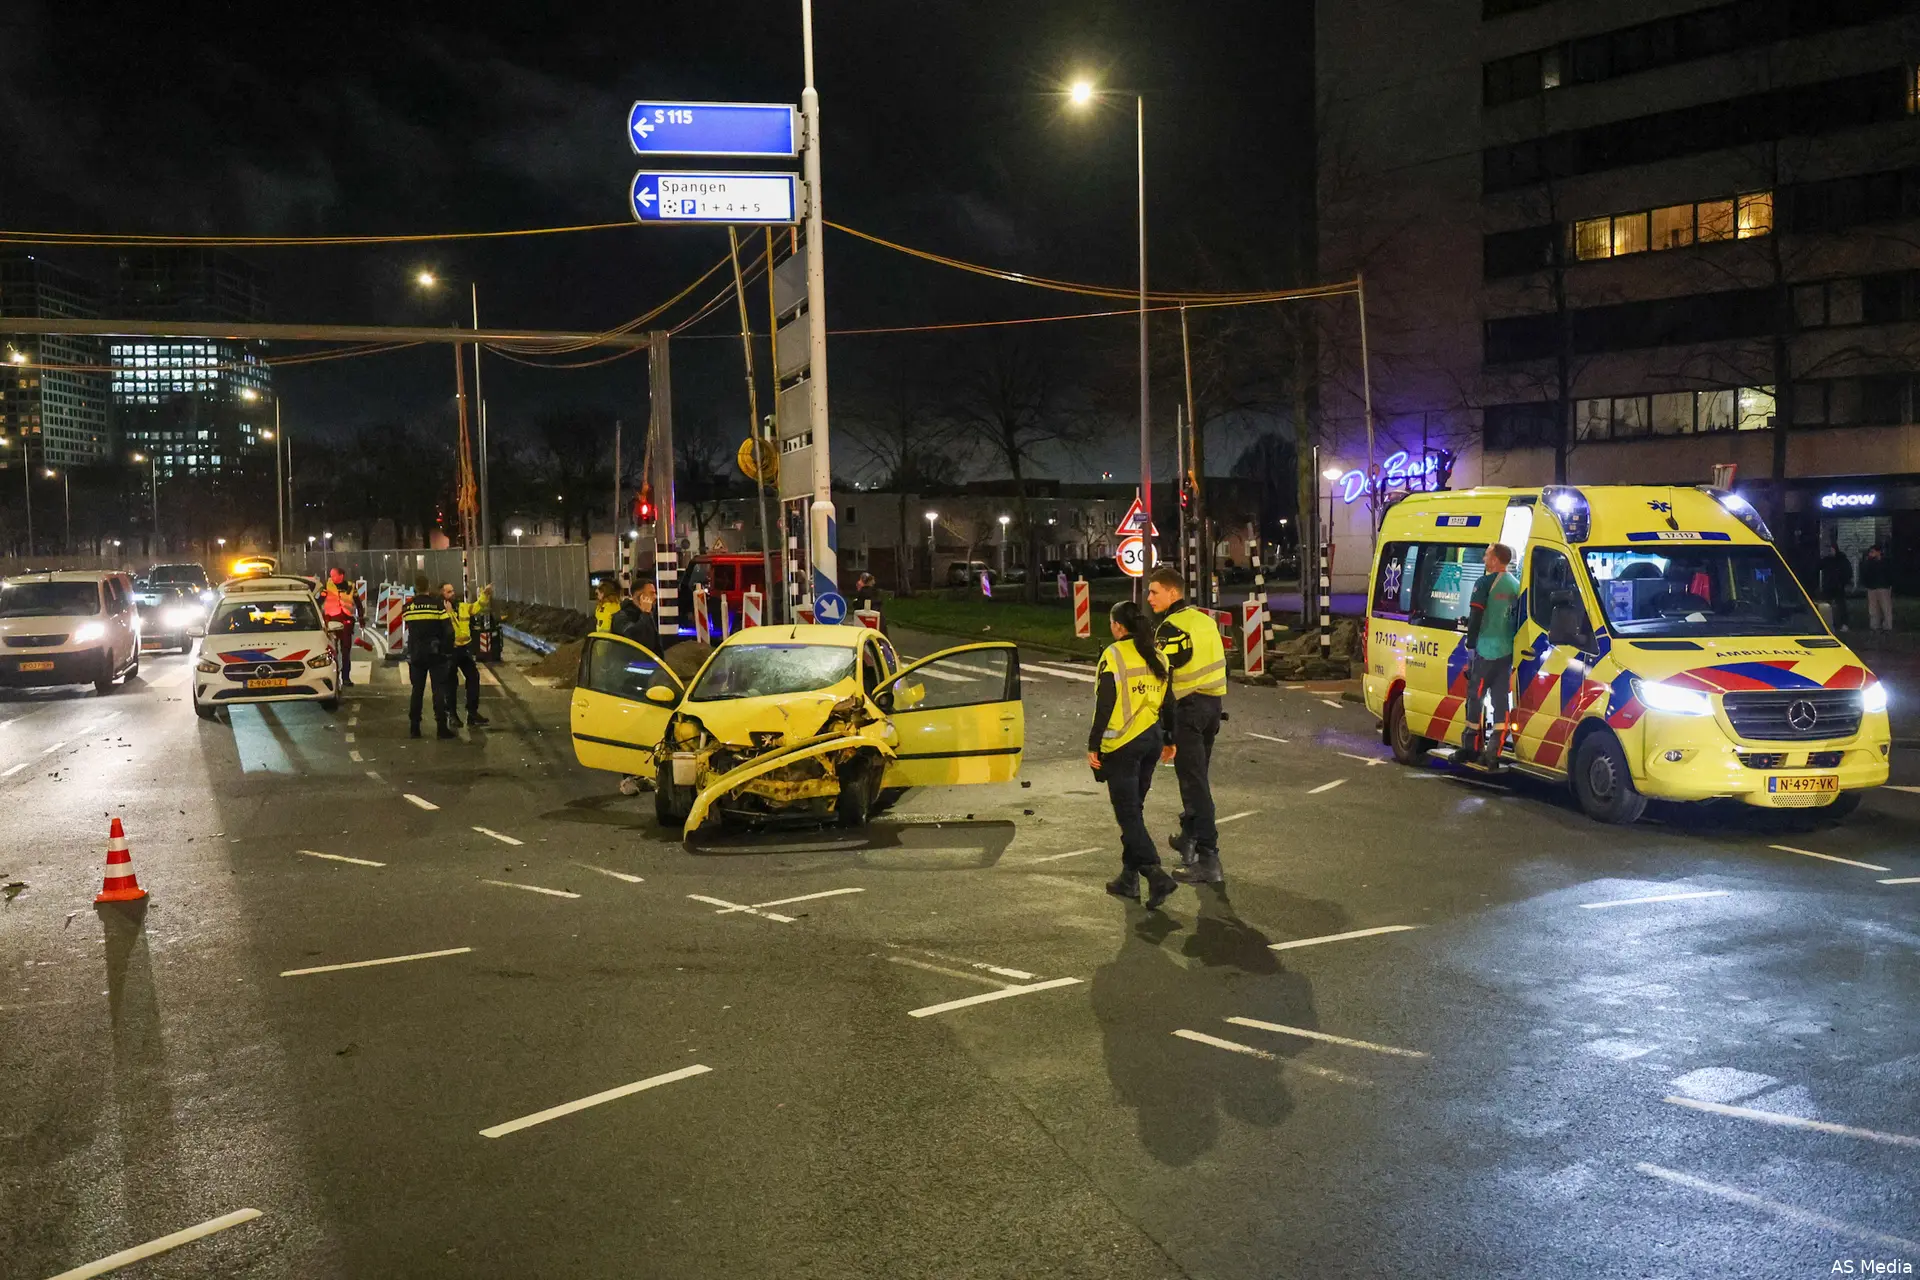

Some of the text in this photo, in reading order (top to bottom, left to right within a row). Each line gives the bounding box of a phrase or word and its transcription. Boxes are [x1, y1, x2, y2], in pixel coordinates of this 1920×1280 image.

[655, 109, 693, 124] S 115
[662, 180, 726, 195] Spangen
[701, 203, 706, 212] 1
[713, 204, 720, 212] +
[726, 203, 733, 212] 4
[740, 204, 747, 212] +
[754, 203, 760, 212] 5
[1822, 492, 1876, 508] gloow
[1431, 590, 1460, 600] AMBULANCE
[1375, 631, 1397, 647] 17-112
[1716, 649, 1815, 658] AMBULANCE
[1780, 778, 1834, 790] N-497-VK
